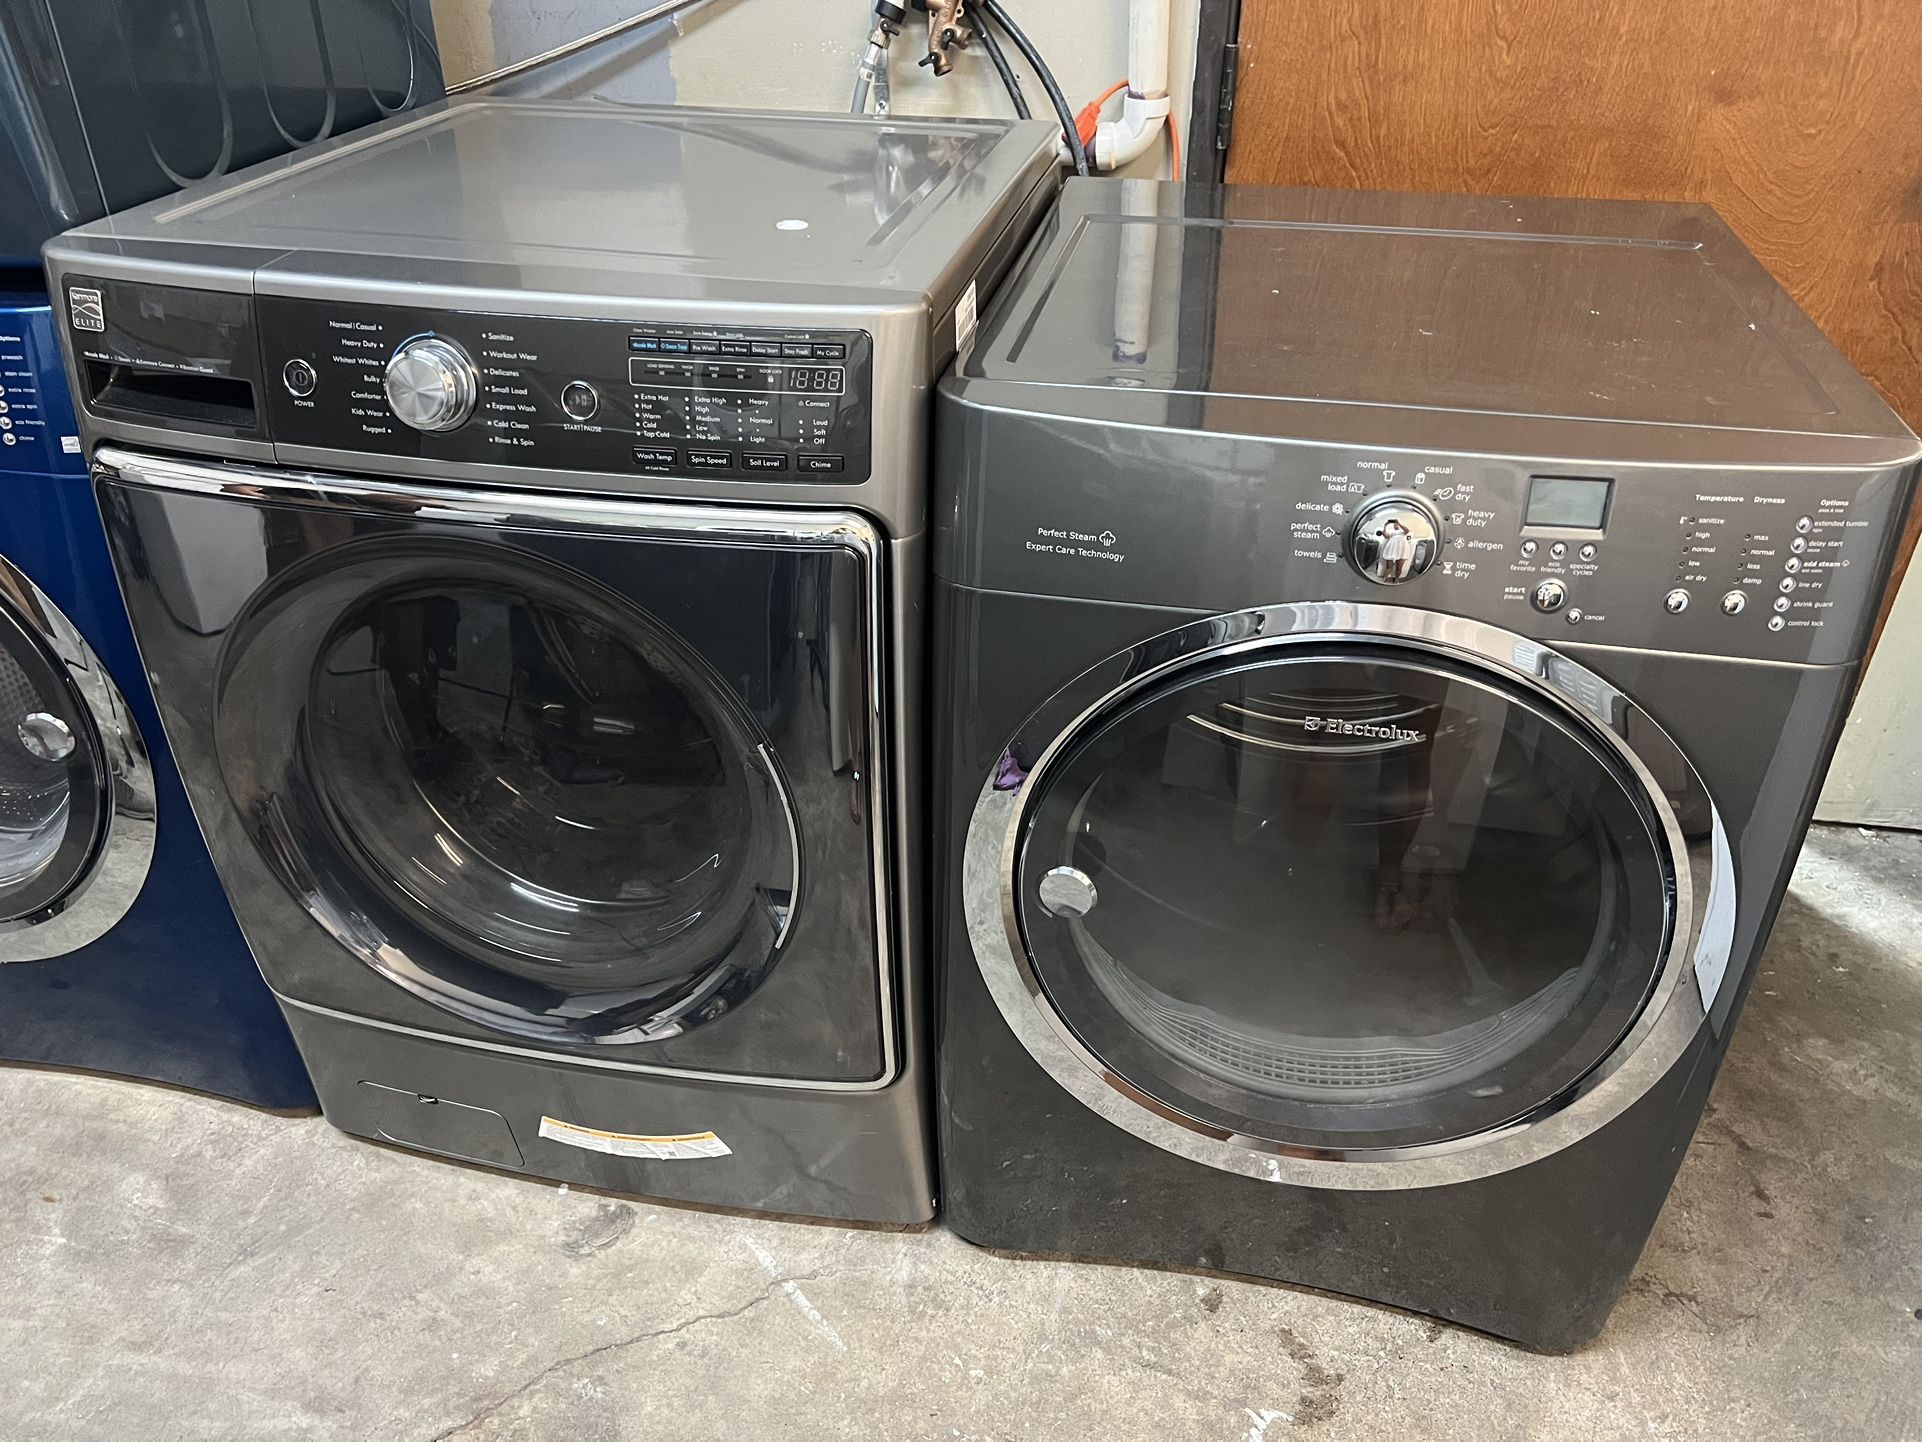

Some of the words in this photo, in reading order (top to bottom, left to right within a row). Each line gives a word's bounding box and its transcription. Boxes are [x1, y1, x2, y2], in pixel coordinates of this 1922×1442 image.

[71, 292, 98, 302] Kenmore
[75, 318, 101, 328] ELITE
[488, 333, 514, 341] Sanitize
[342, 339, 361, 347] Heavy
[363, 340, 377, 348] Duty
[333, 355, 356, 364] Whitest
[357, 358, 379, 366] Whites
[489, 351, 517, 359] Workout
[519, 353, 538, 361] Wear
[489, 368, 519, 377] Delicates
[363, 374, 380, 383] Bulky
[491, 386, 509, 394] Small
[511, 387, 528, 395] Load
[351, 391, 381, 400] Comforter
[294, 400, 315, 408] POWER
[712, 397, 727, 405] High
[748, 398, 769, 406] Heavy
[491, 402, 516, 411] Express
[518, 404, 536, 412] Wash
[366, 409, 384, 417] Wear
[493, 420, 509, 428] Cold
[510, 421, 530, 429] Clean
[362, 425, 386, 434] Rugged
[643, 430, 655, 438] Tap
[494, 436, 512, 444] Rinse
[520, 438, 535, 446] Spin
[750, 436, 766, 444] Light
[636, 452, 655, 460] Wash
[656, 454, 672, 462] Temp
[691, 455, 706, 463] Spin
[706, 456, 727, 464] Speed
[810, 461, 832, 469] Chime
[1357, 460, 1389, 470] normal
[1424, 465, 1453, 474] casual
[1320, 474, 1348, 483] mixed
[1327, 483, 1347, 493] load
[1456, 484, 1474, 493] fast
[1455, 493, 1471, 503] dry
[1695, 494, 1744, 502] Temperature
[1753, 496, 1786, 504] Dryness
[1295, 502, 1330, 512] delicate
[1467, 509, 1495, 520] heavy
[1290, 522, 1321, 533] perfect
[1466, 518, 1487, 528] duty
[1037, 527, 1068, 539] Perfect
[1069, 531, 1097, 542] Steam
[1293, 531, 1320, 540] steam
[1694, 532, 1710, 540] high
[1467, 540, 1504, 551] allergen
[1025, 541, 1054, 553] Expert
[1055, 545, 1076, 555] Care
[1077, 547, 1125, 563] Technology
[1294, 549, 1322, 559] towels
[1750, 549, 1776, 557] normal
[1456, 561, 1477, 570] time
[1510, 564, 1536, 572] favorite
[1540, 566, 1566, 574] friendly
[1569, 563, 1599, 572] specialty
[1454, 570, 1470, 580] dry
[1742, 577, 1763, 585] damp
[1325, 718, 1419, 742] Electrolux
